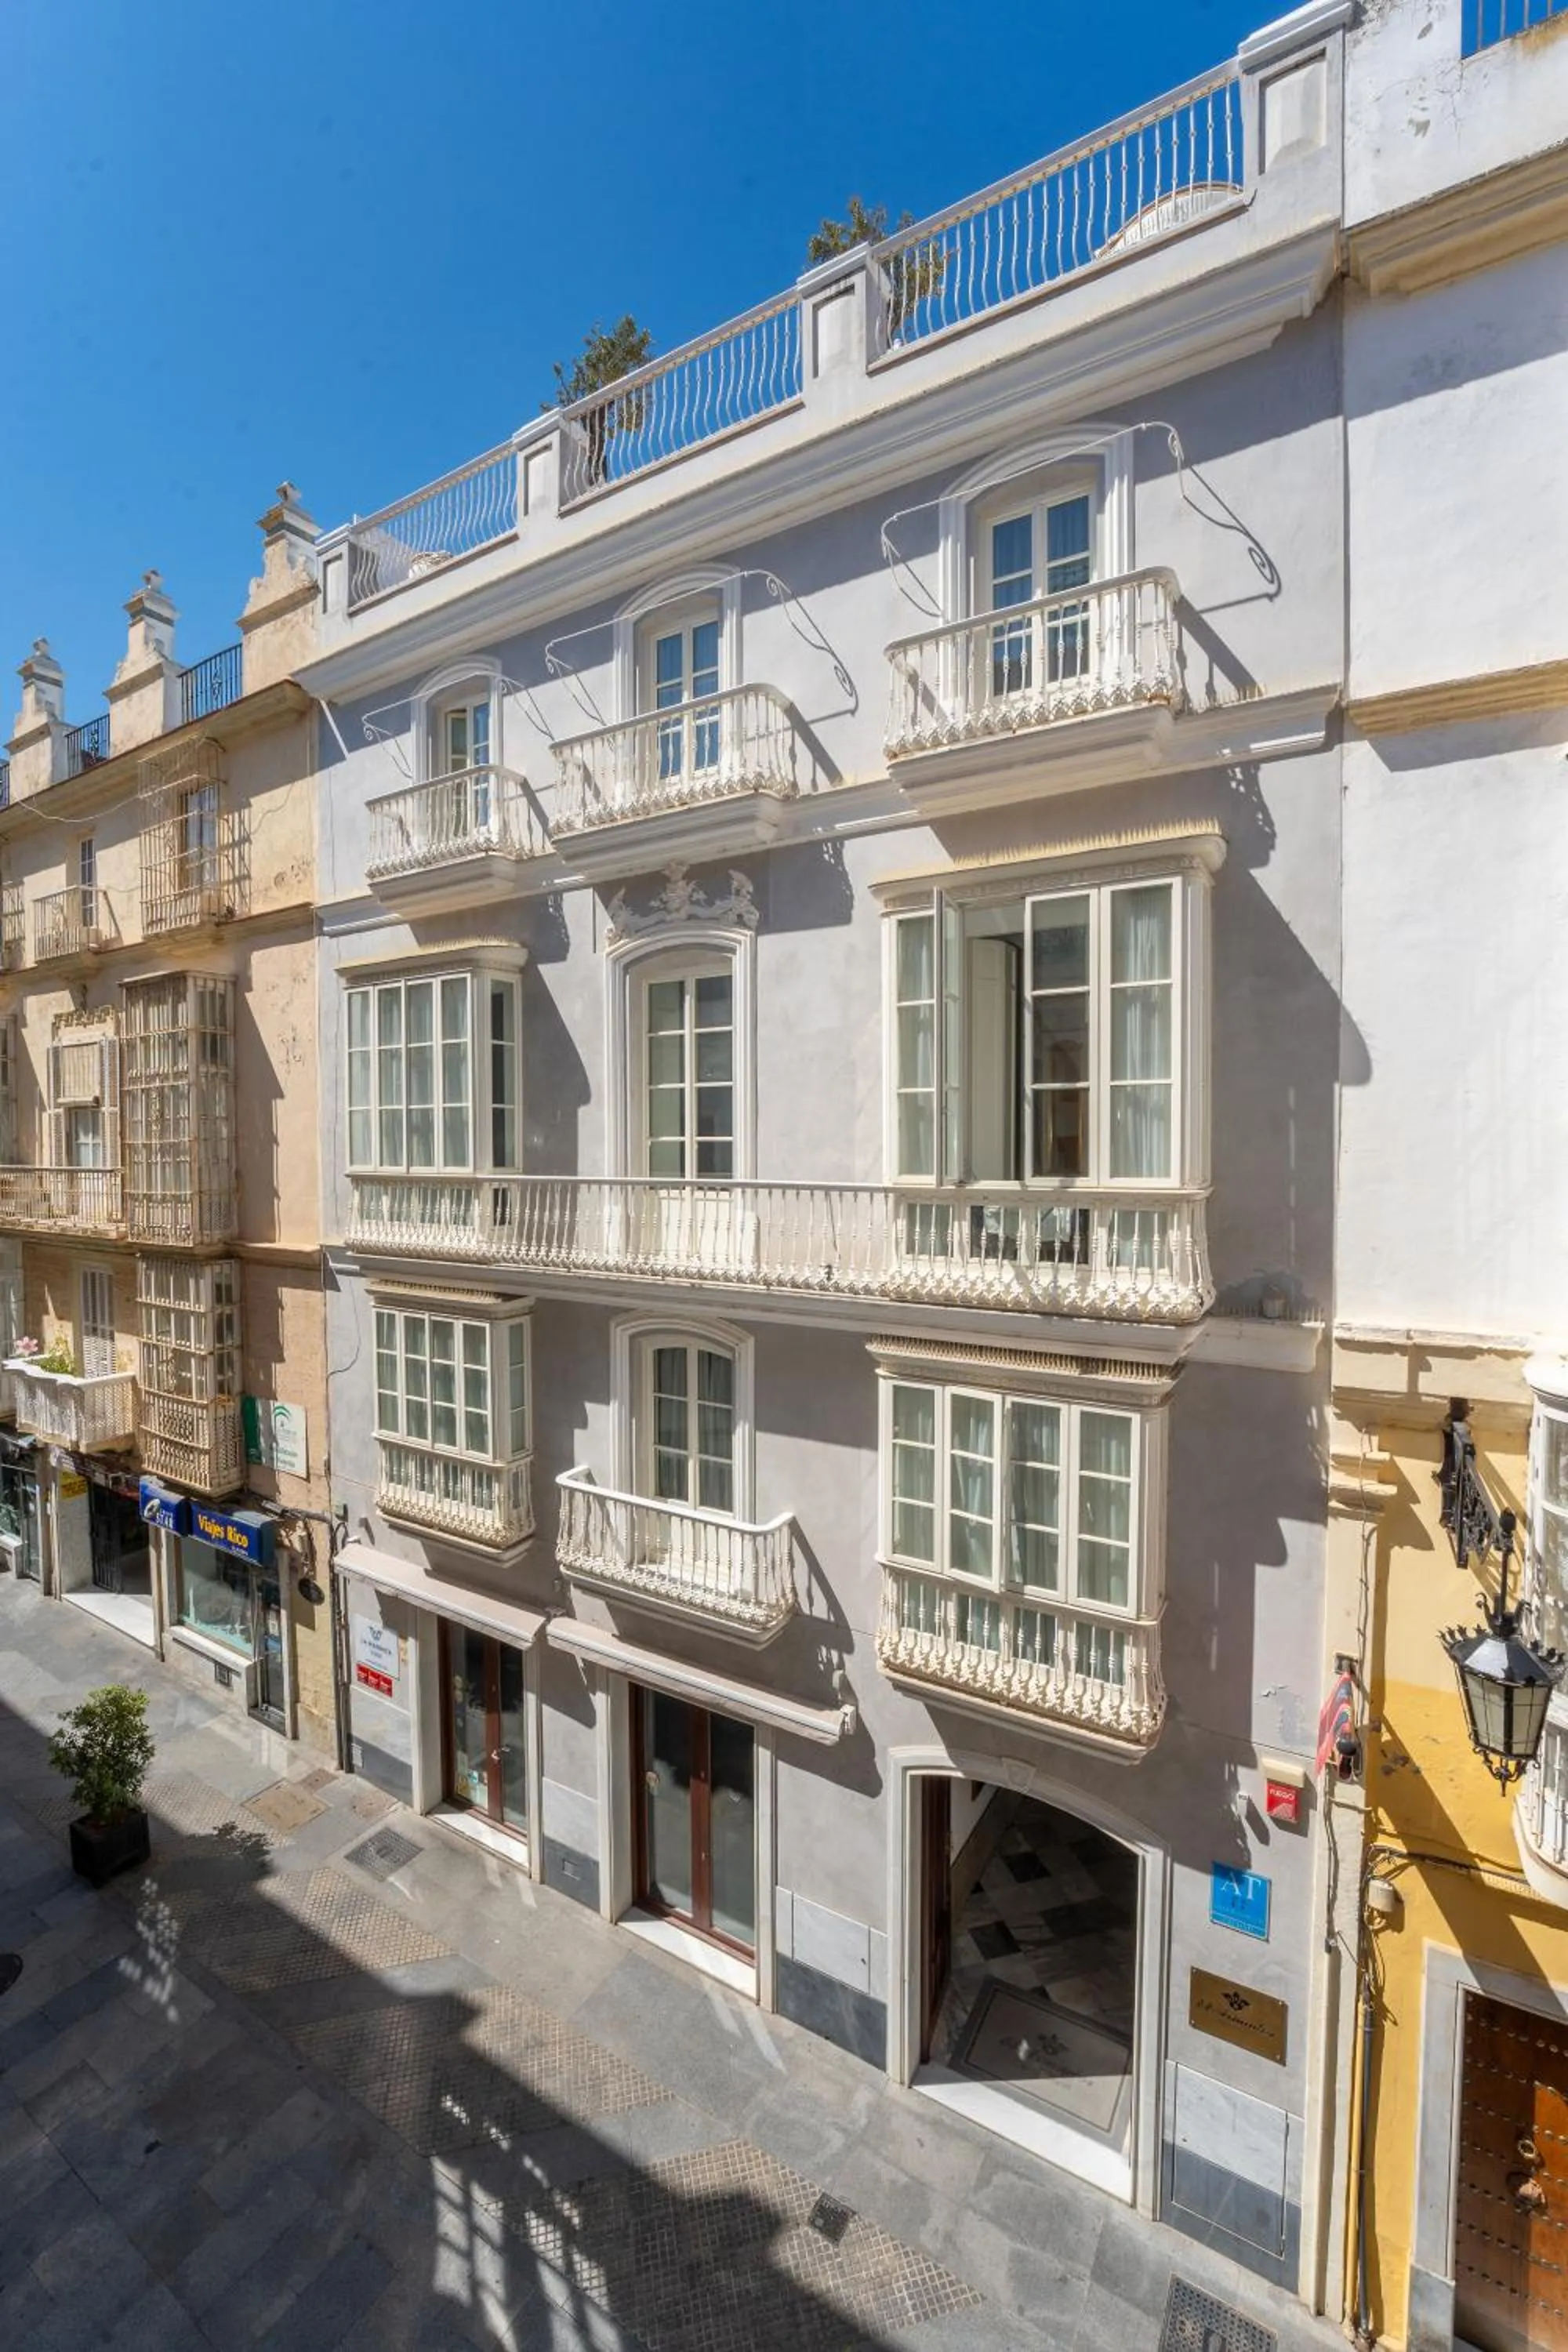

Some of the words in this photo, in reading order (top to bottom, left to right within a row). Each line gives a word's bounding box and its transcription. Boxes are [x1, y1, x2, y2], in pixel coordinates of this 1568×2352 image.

[198, 1515, 224, 1538] Viajes
[227, 1525, 249, 1547] Rico
[1221, 1871, 1261, 1900] AT
